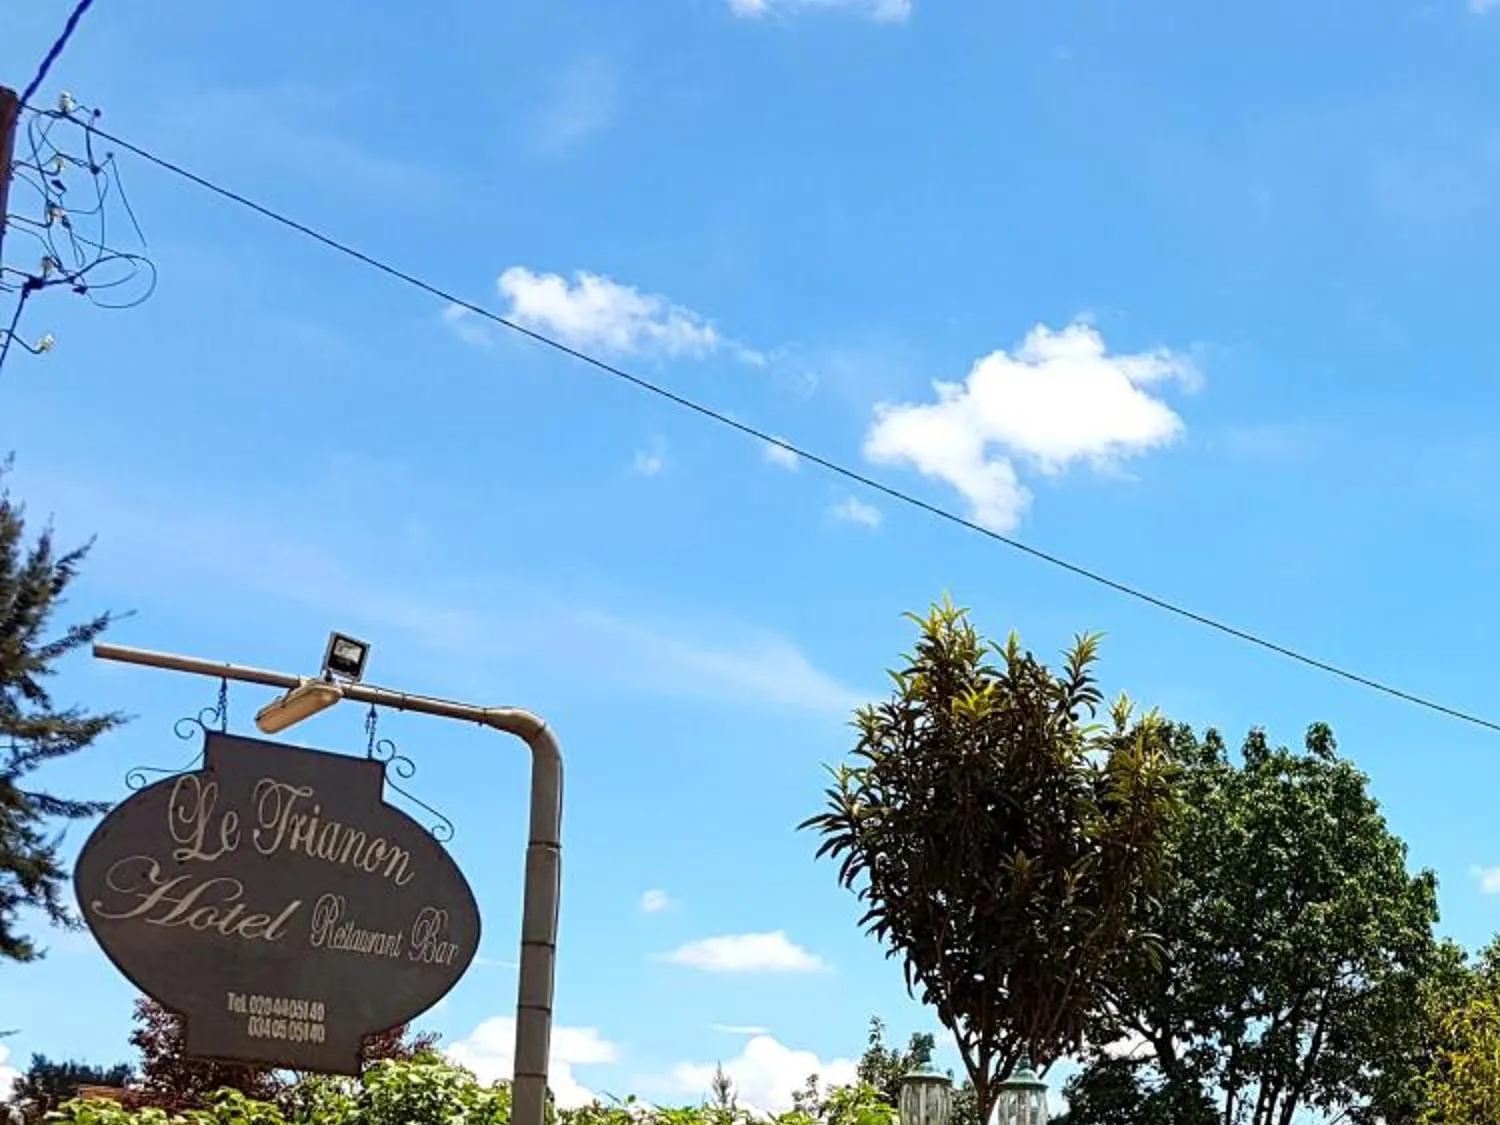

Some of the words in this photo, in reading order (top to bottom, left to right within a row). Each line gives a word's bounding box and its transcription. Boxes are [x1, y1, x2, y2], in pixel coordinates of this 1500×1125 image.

[168, 774, 240, 861] Le
[252, 778, 414, 885] Trianon
[91, 856, 300, 942] Hotel
[408, 906, 458, 966] Bar
